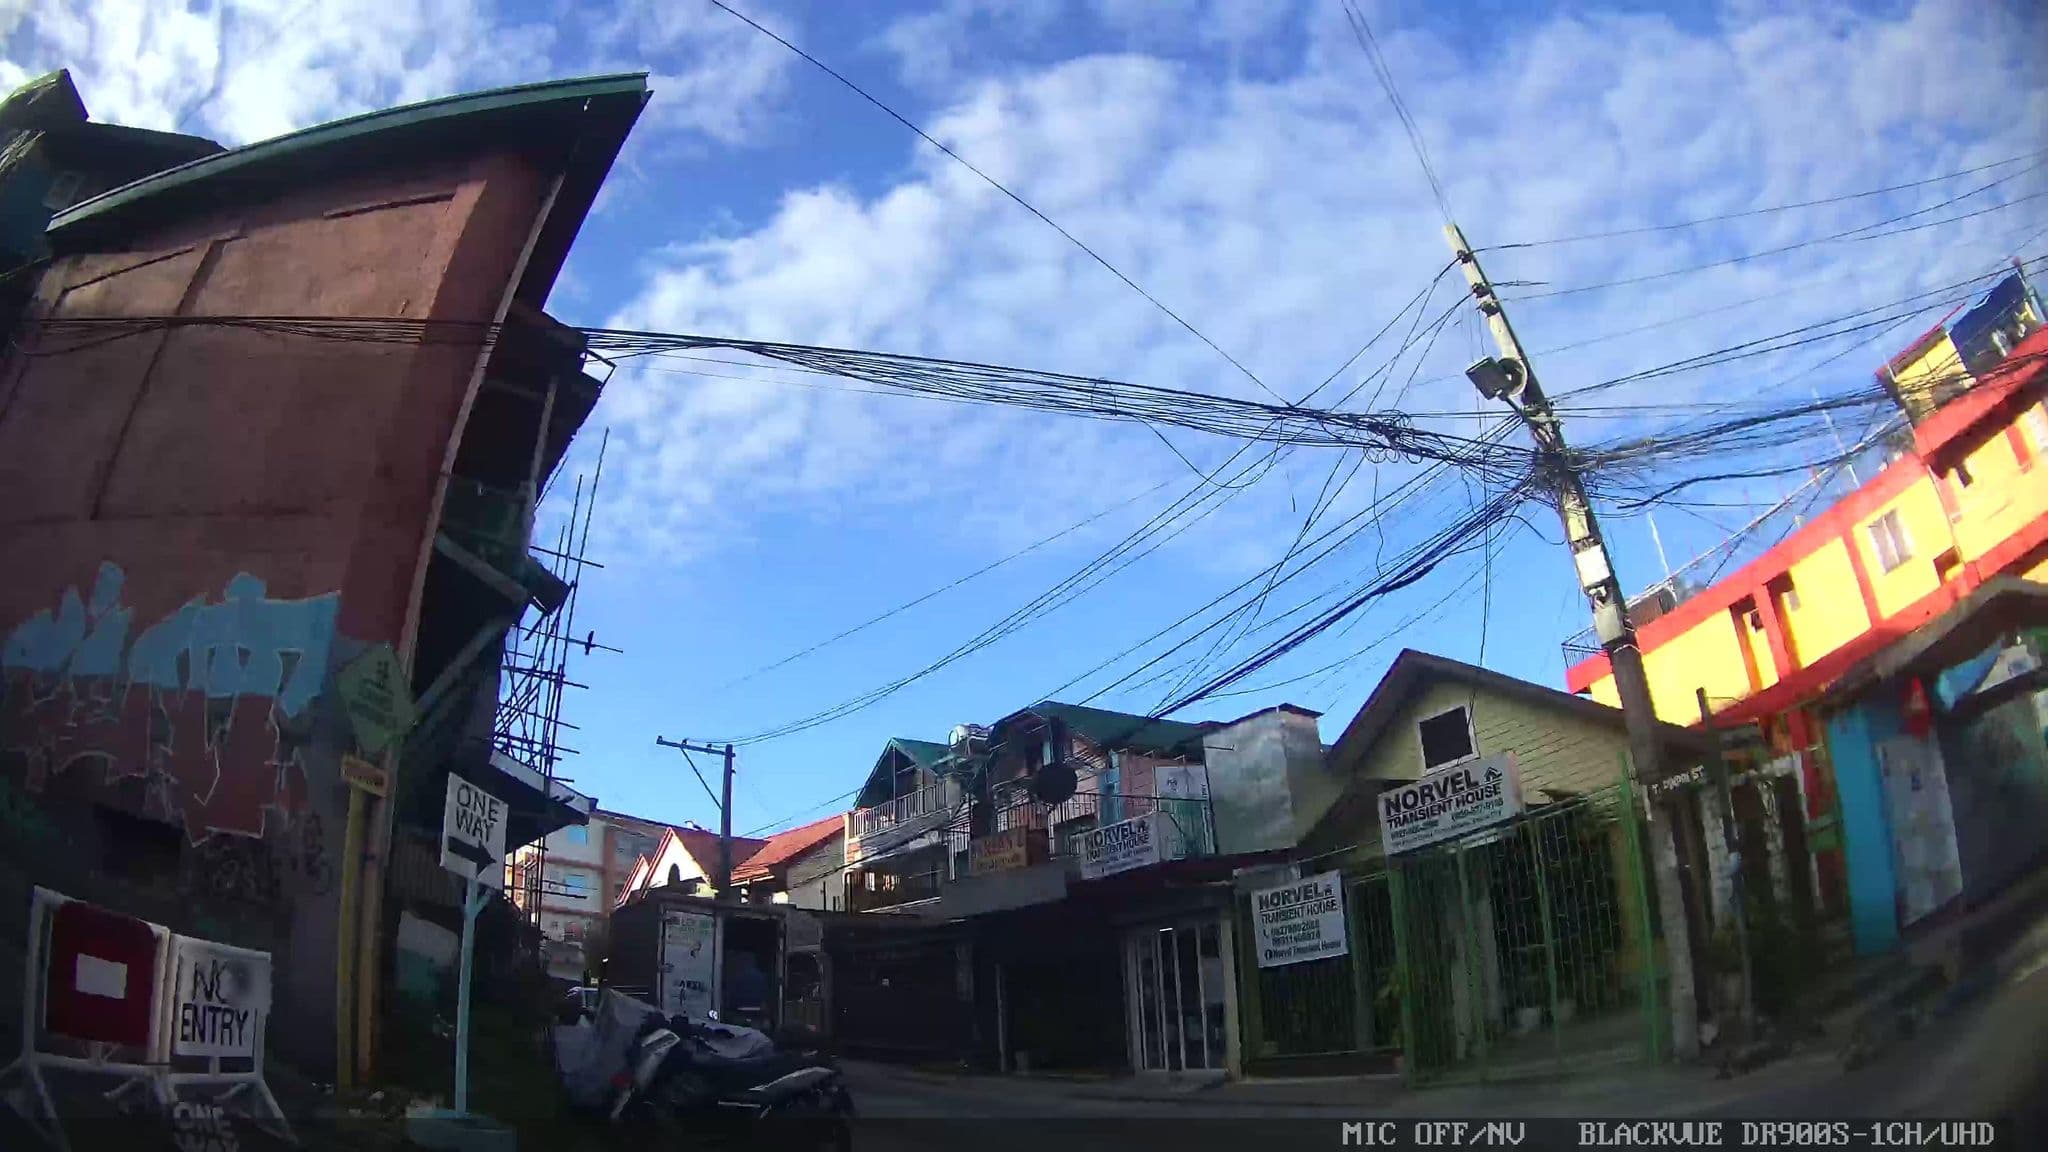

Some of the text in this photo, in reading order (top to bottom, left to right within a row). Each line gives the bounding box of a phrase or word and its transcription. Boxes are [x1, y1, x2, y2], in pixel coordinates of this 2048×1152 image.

[457, 783, 499, 823] ONE
[1384, 769, 1480, 816] NORVEL
[1387, 797, 1455, 829] TRANSIENT
[1456, 782, 1502, 808] HOUSE
[456, 806, 494, 842] WAY
[1084, 820, 1136, 850] NORVEL
[1259, 882, 1322, 909] NORVEL
[1261, 899, 1338, 924] TRANSIENT HOUSE
[181, 1003, 248, 1046] ENTRY
[173, 1101, 231, 1133] ONE
